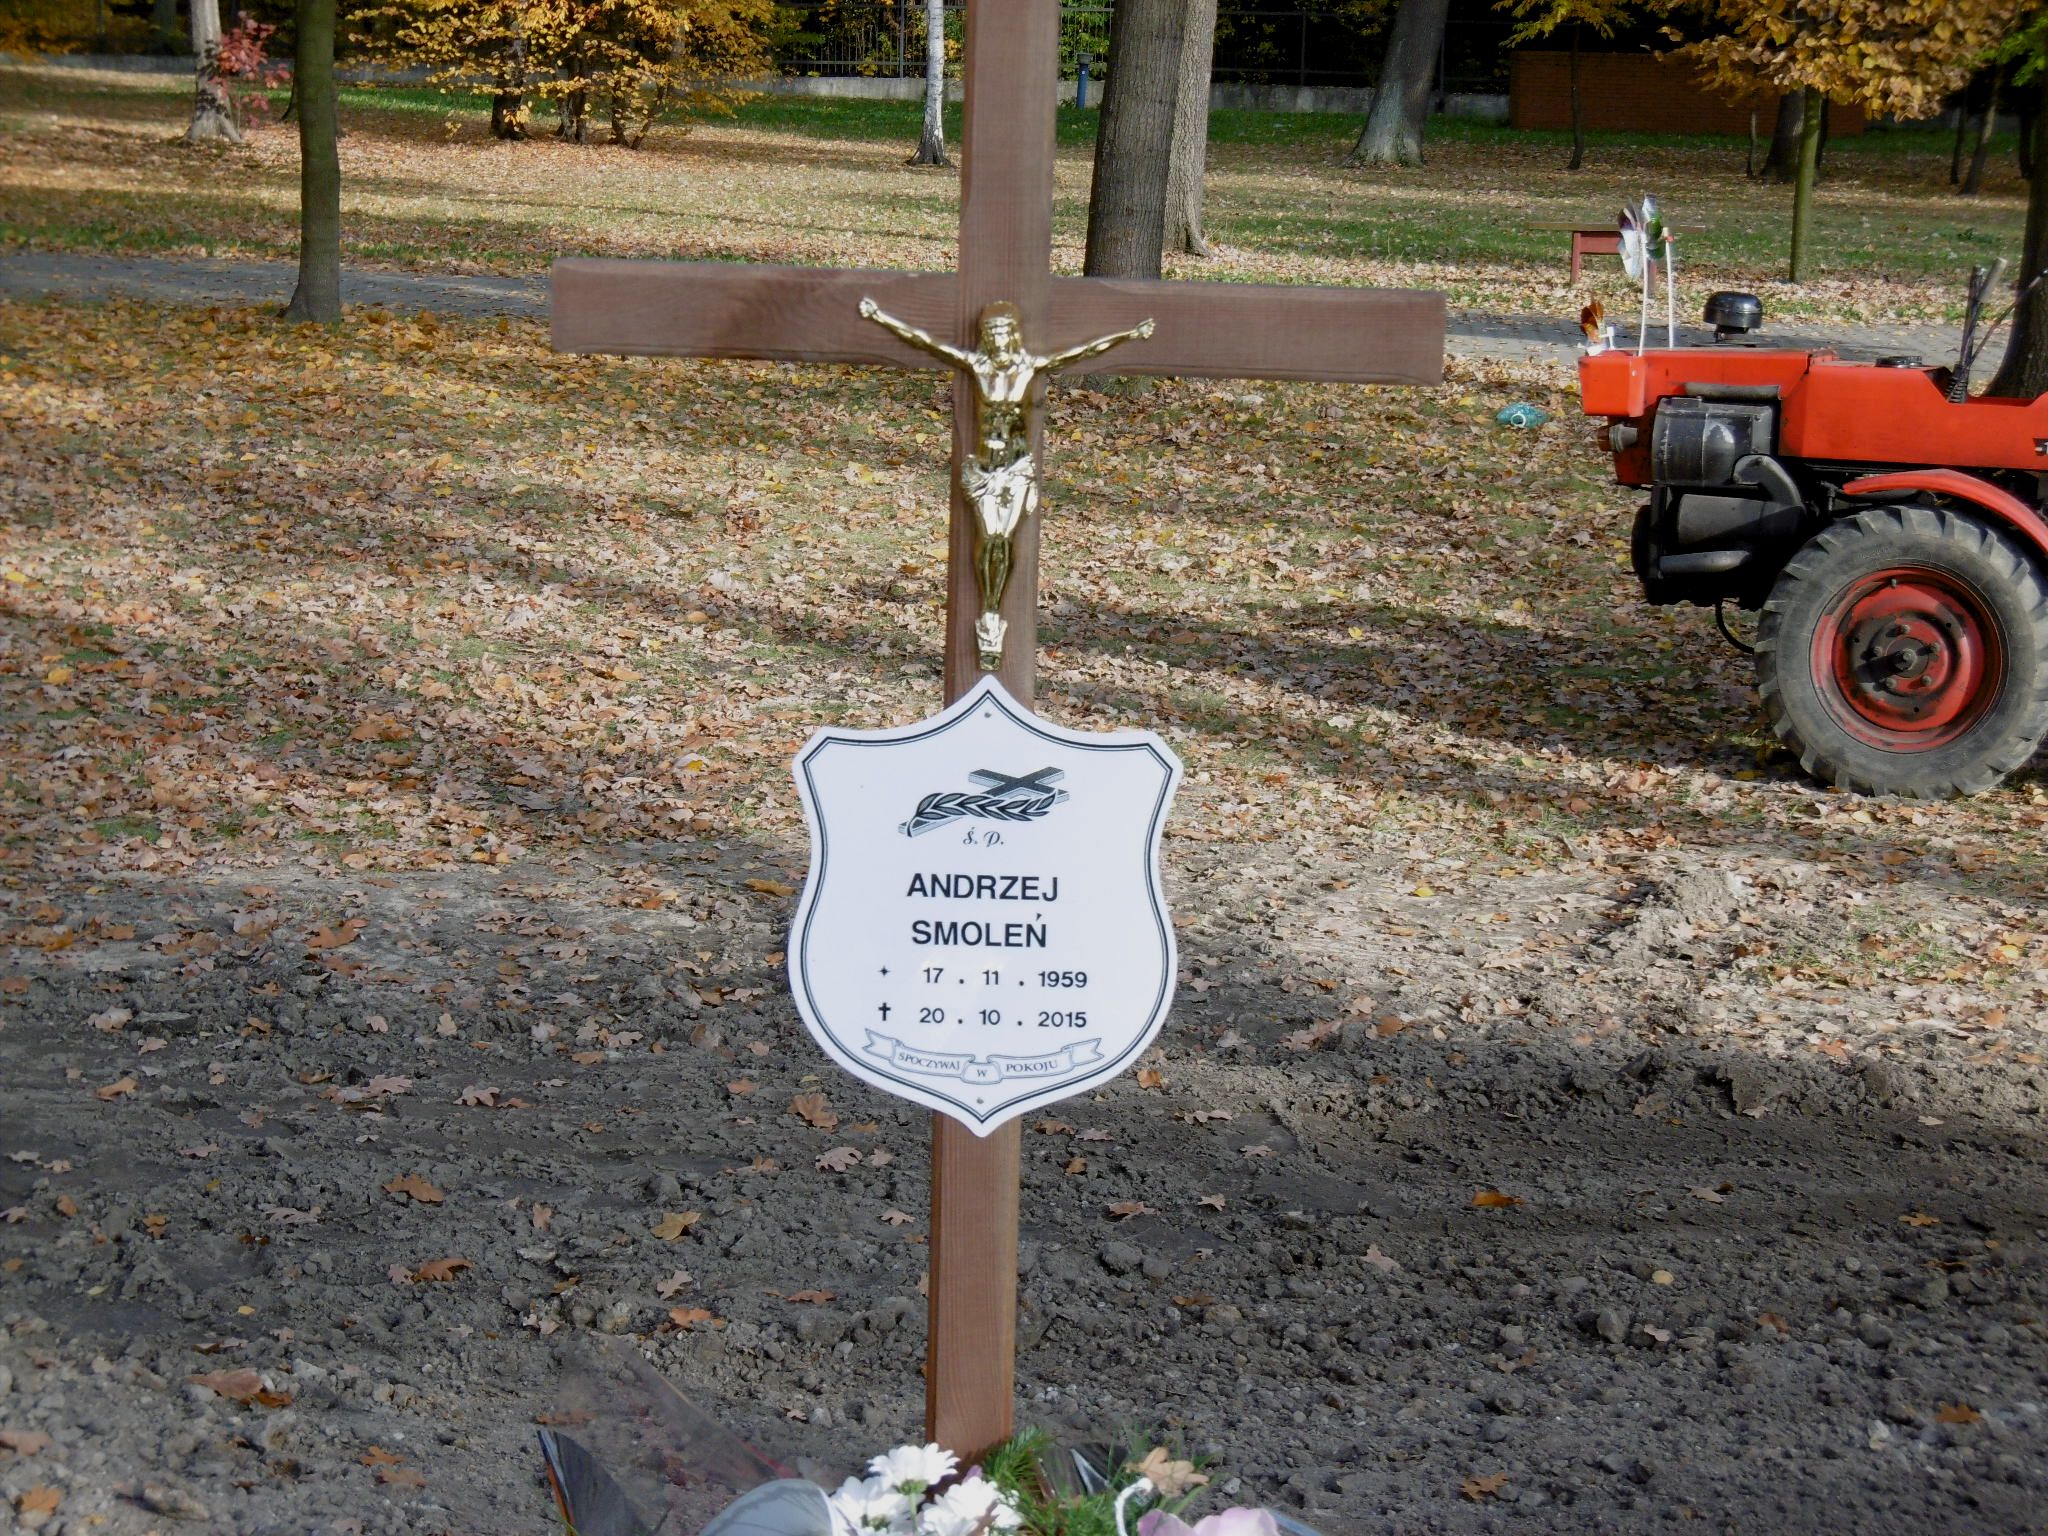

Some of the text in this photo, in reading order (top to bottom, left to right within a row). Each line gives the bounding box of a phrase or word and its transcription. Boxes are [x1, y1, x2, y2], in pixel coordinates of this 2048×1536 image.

[906, 872, 1059, 902] ANDRZEJ
[911, 913, 1047, 948] SMOLEŃ
[1038, 970, 1088, 988] 1959
[1038, 1011, 1087, 1028] 2015
[898, 1052, 960, 1071] SPOCZYWAJ
[1006, 1060, 1058, 1072] POKOJU
